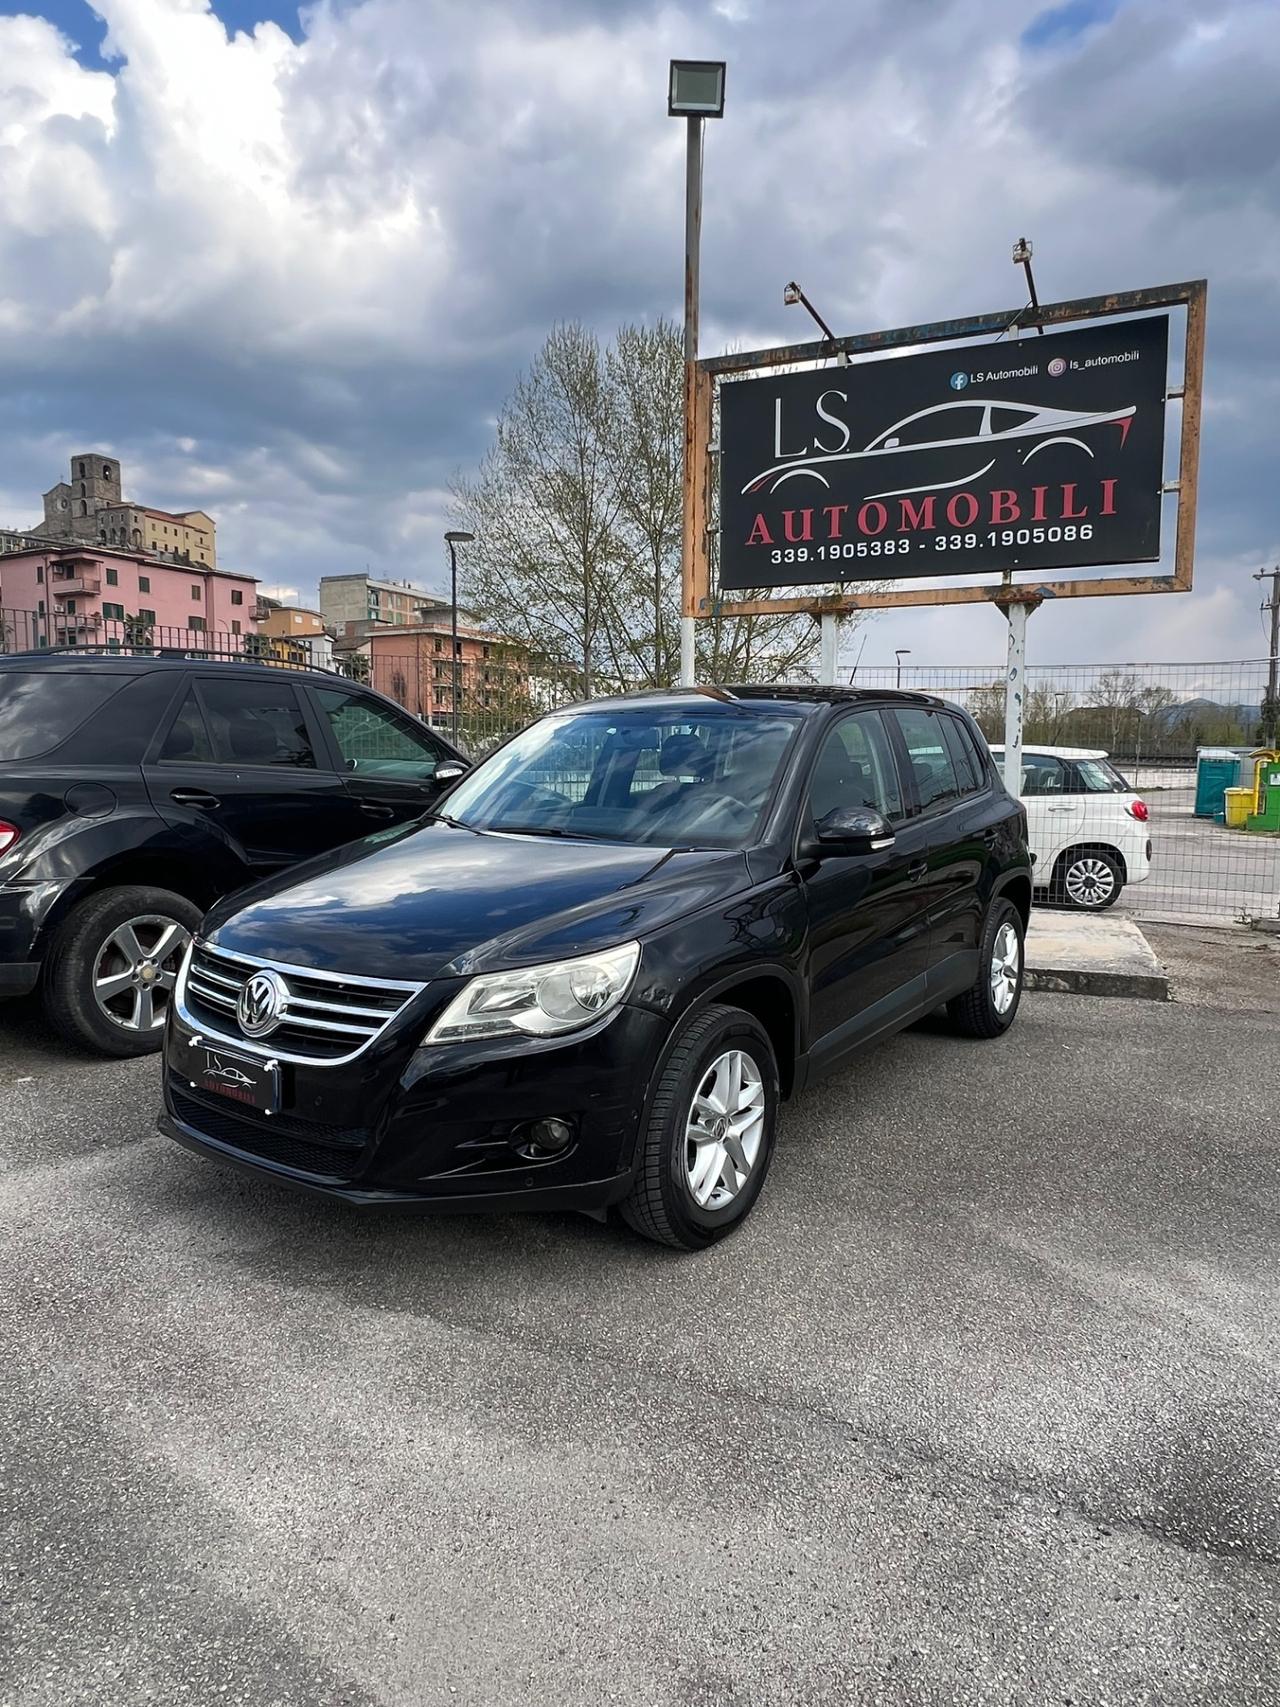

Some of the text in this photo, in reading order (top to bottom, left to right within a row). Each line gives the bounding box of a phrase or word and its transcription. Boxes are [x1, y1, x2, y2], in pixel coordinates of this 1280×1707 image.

[970, 365, 1038, 384] LS Automobili
[745, 479, 1119, 546] AUTOMOBILI
[771, 538, 910, 564] 339.1905383
[935, 524, 1093, 551] 339.1905086
